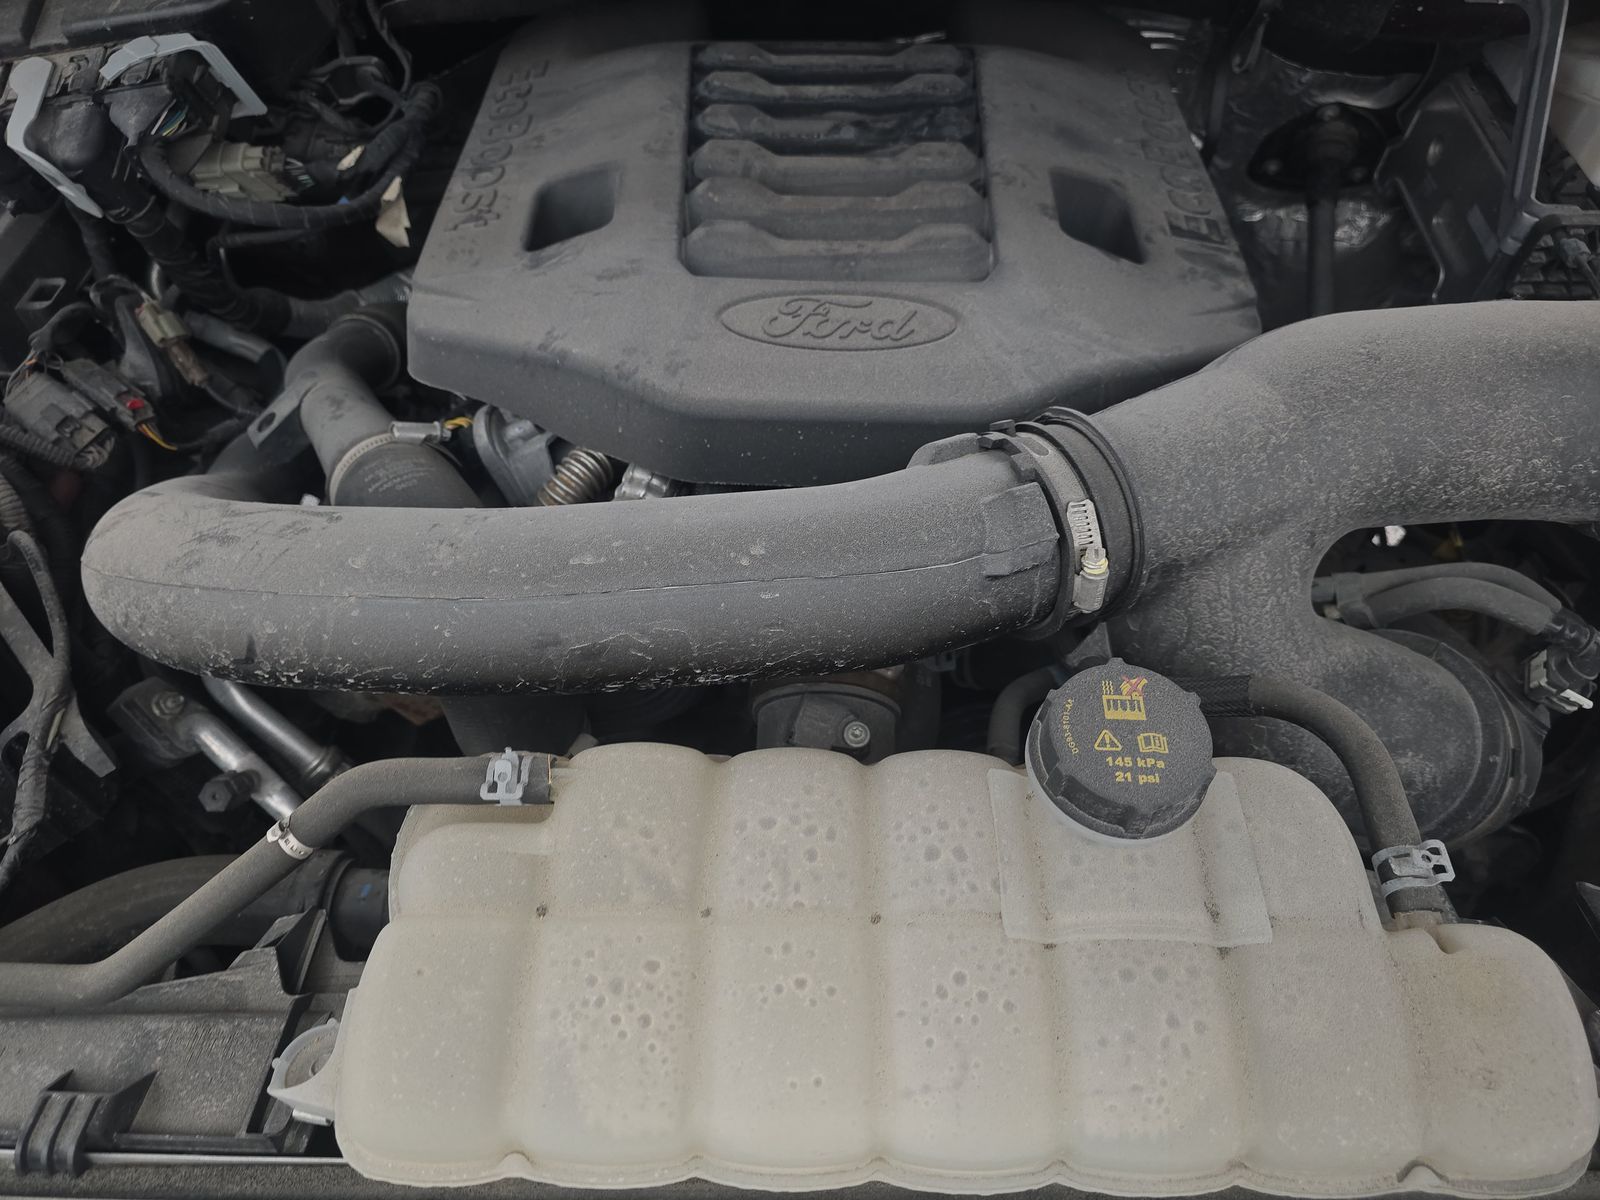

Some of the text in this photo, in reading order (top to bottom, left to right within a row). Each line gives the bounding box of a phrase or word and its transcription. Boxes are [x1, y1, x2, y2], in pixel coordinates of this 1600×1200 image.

[762, 297, 917, 339] Ford
[1106, 756, 1165, 768] 145 kPa
[1115, 771, 1160, 784] 21 psi
